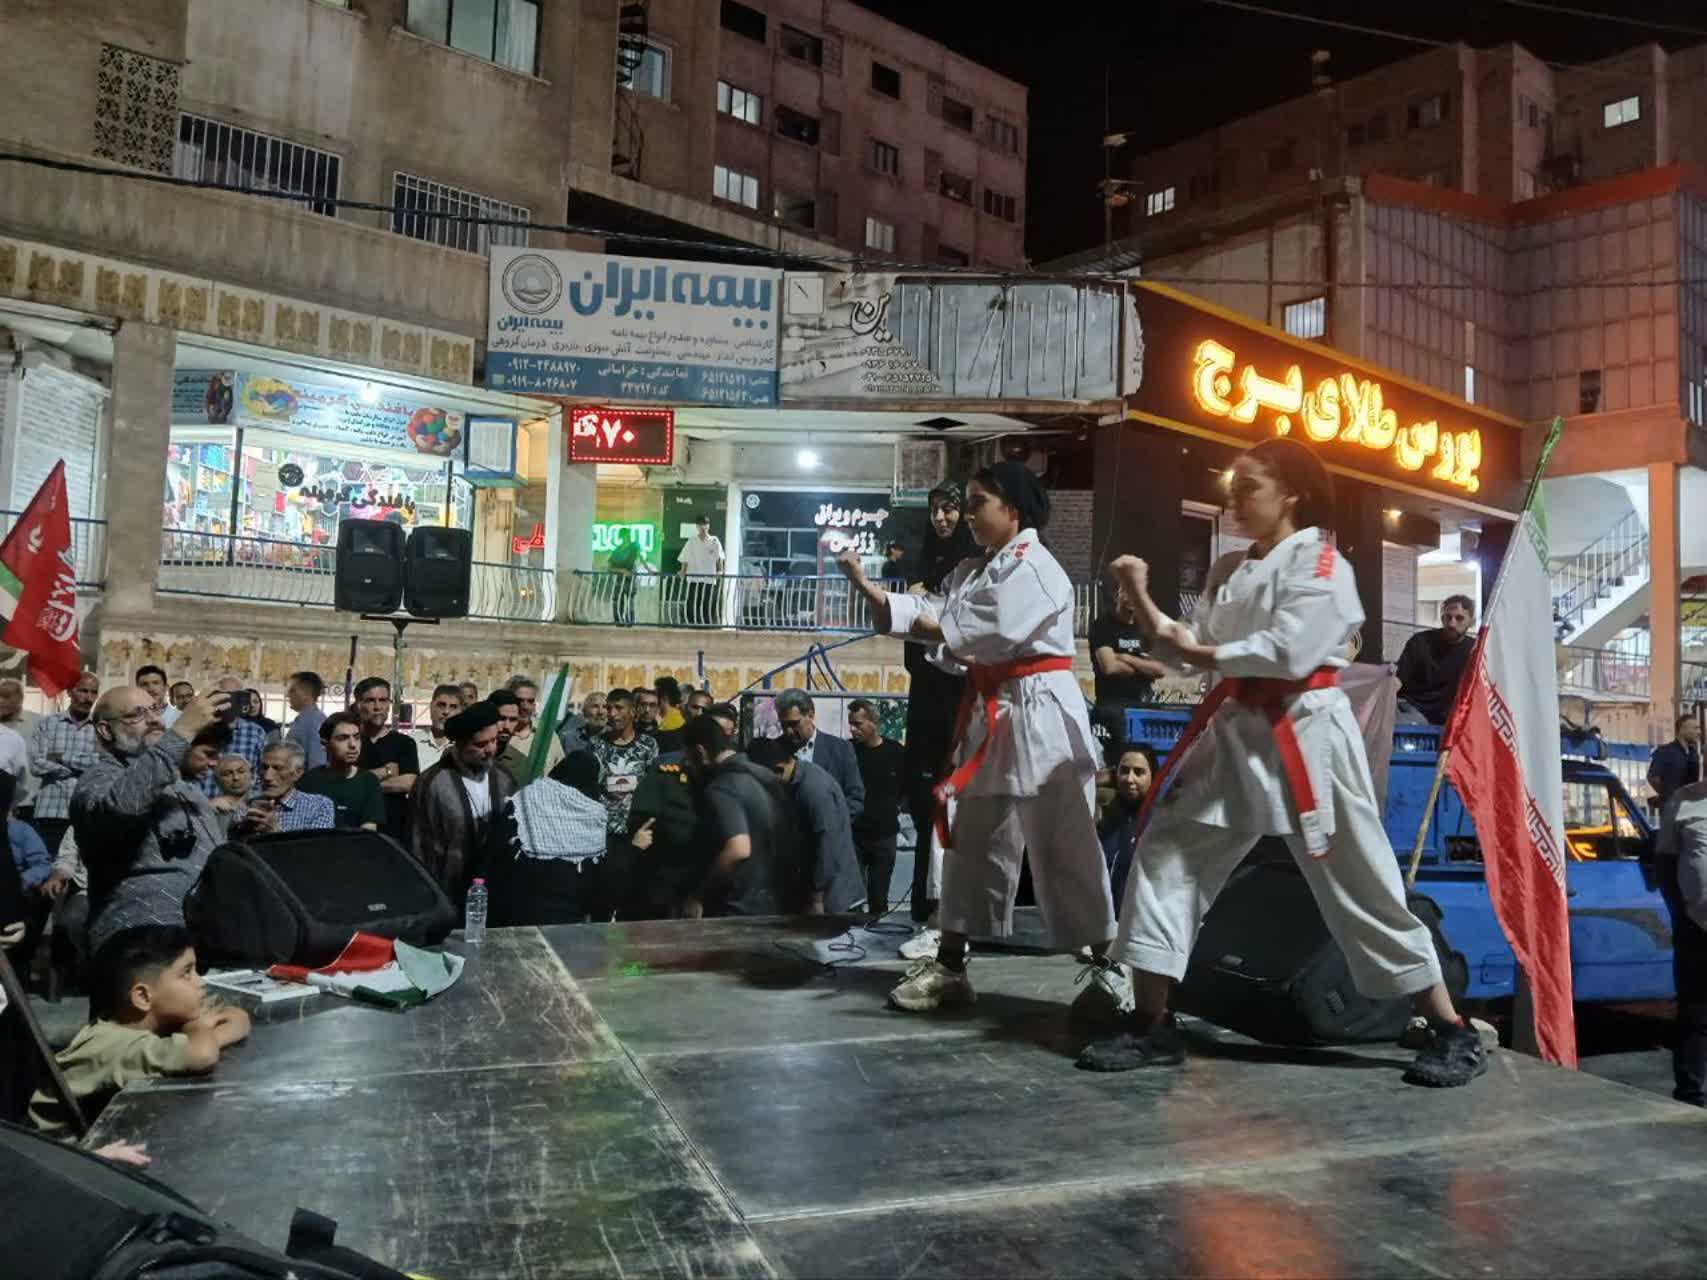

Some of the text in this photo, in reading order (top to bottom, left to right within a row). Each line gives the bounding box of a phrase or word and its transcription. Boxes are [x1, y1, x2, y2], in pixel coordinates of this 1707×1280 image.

[497, 315, 563, 335] بیمه ایران
[569, 261, 773, 331] بیمه ایران
[1194, 338, 1304, 436] برج
[1303, 371, 1398, 450] طلای
